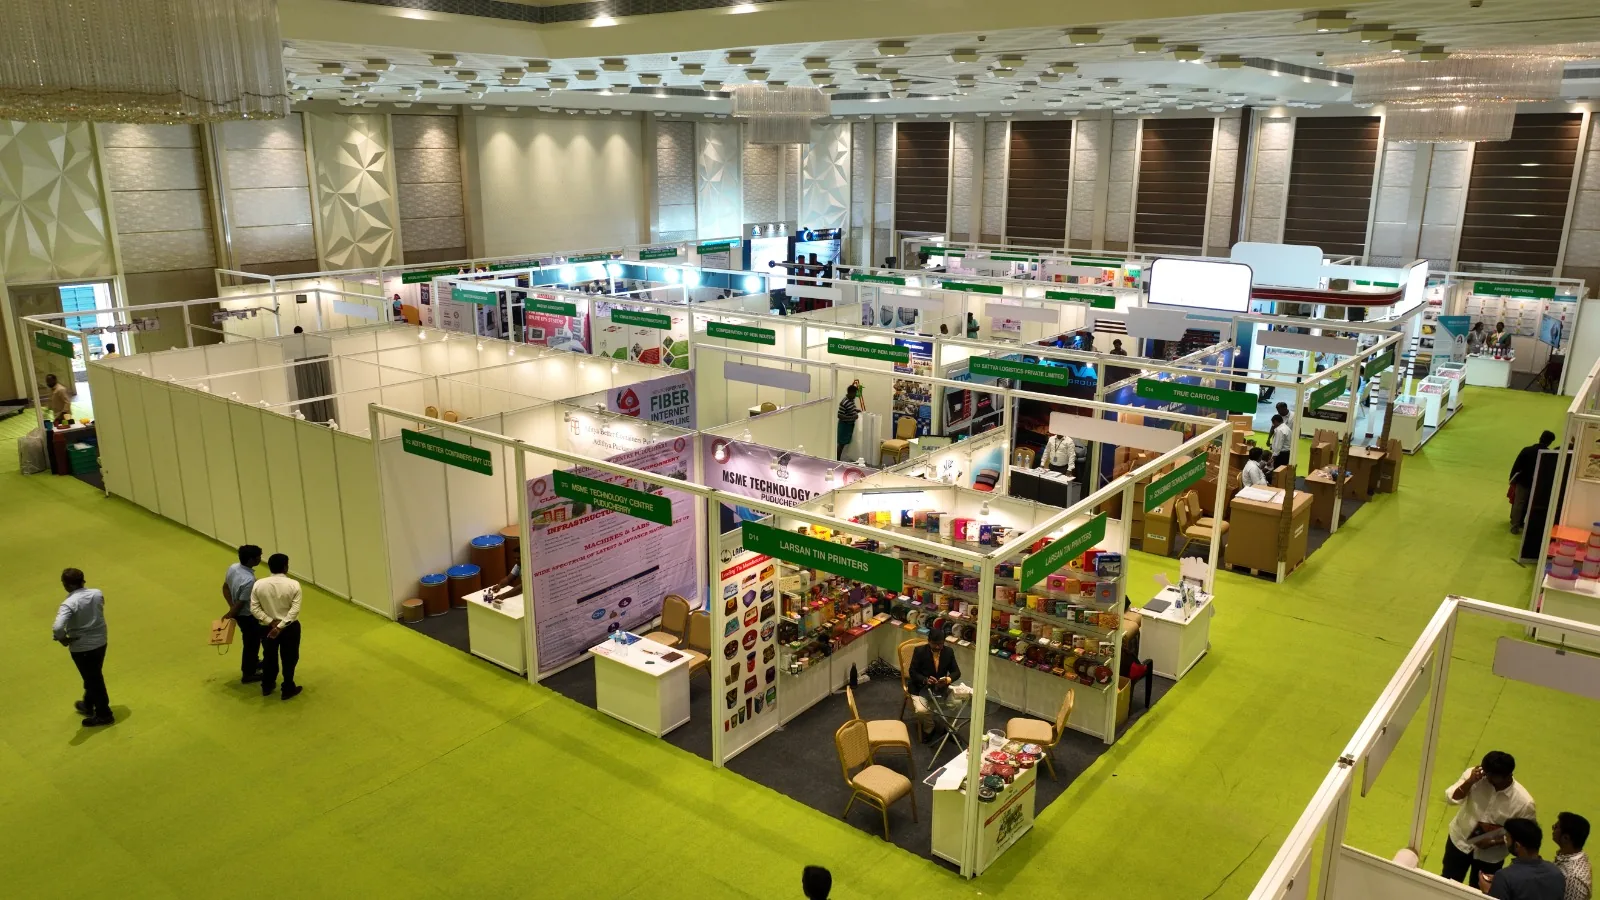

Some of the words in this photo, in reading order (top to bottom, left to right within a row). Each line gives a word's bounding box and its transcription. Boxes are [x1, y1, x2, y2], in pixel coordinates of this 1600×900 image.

[981, 363, 999, 372] SATTVA
[1000, 366, 1024, 375] LOGISTICS
[1045, 371, 1065, 380] LIMITED
[650, 390, 691, 412] FIBER
[1173, 389, 1190, 398] TRUE
[1190, 392, 1220, 402] CARTONS
[650, 405, 690, 422] INTERNET
[675, 416, 692, 426] LINE
[427, 444, 444, 454] BETTER
[445, 448, 472, 462] CONTAINERS
[472, 456, 482, 465] PVT
[722, 469, 747, 489] MSME
[750, 480, 811, 502] TECHNOLOGY
[571, 483, 588, 495] MSME
[590, 488, 628, 505] TECHNOLOGY
[630, 498, 654, 512] CENTRE
[593, 498, 632, 515] PUDUCHERRY
[631, 521, 650, 534] LABS
[780, 540, 811, 558] LARSAN
[813, 548, 826, 561] TIN
[828, 552, 869, 573] PRINTERS
[1045, 547, 1064, 567] LARSAN
[1070, 531, 1092, 552] PRINTERS
